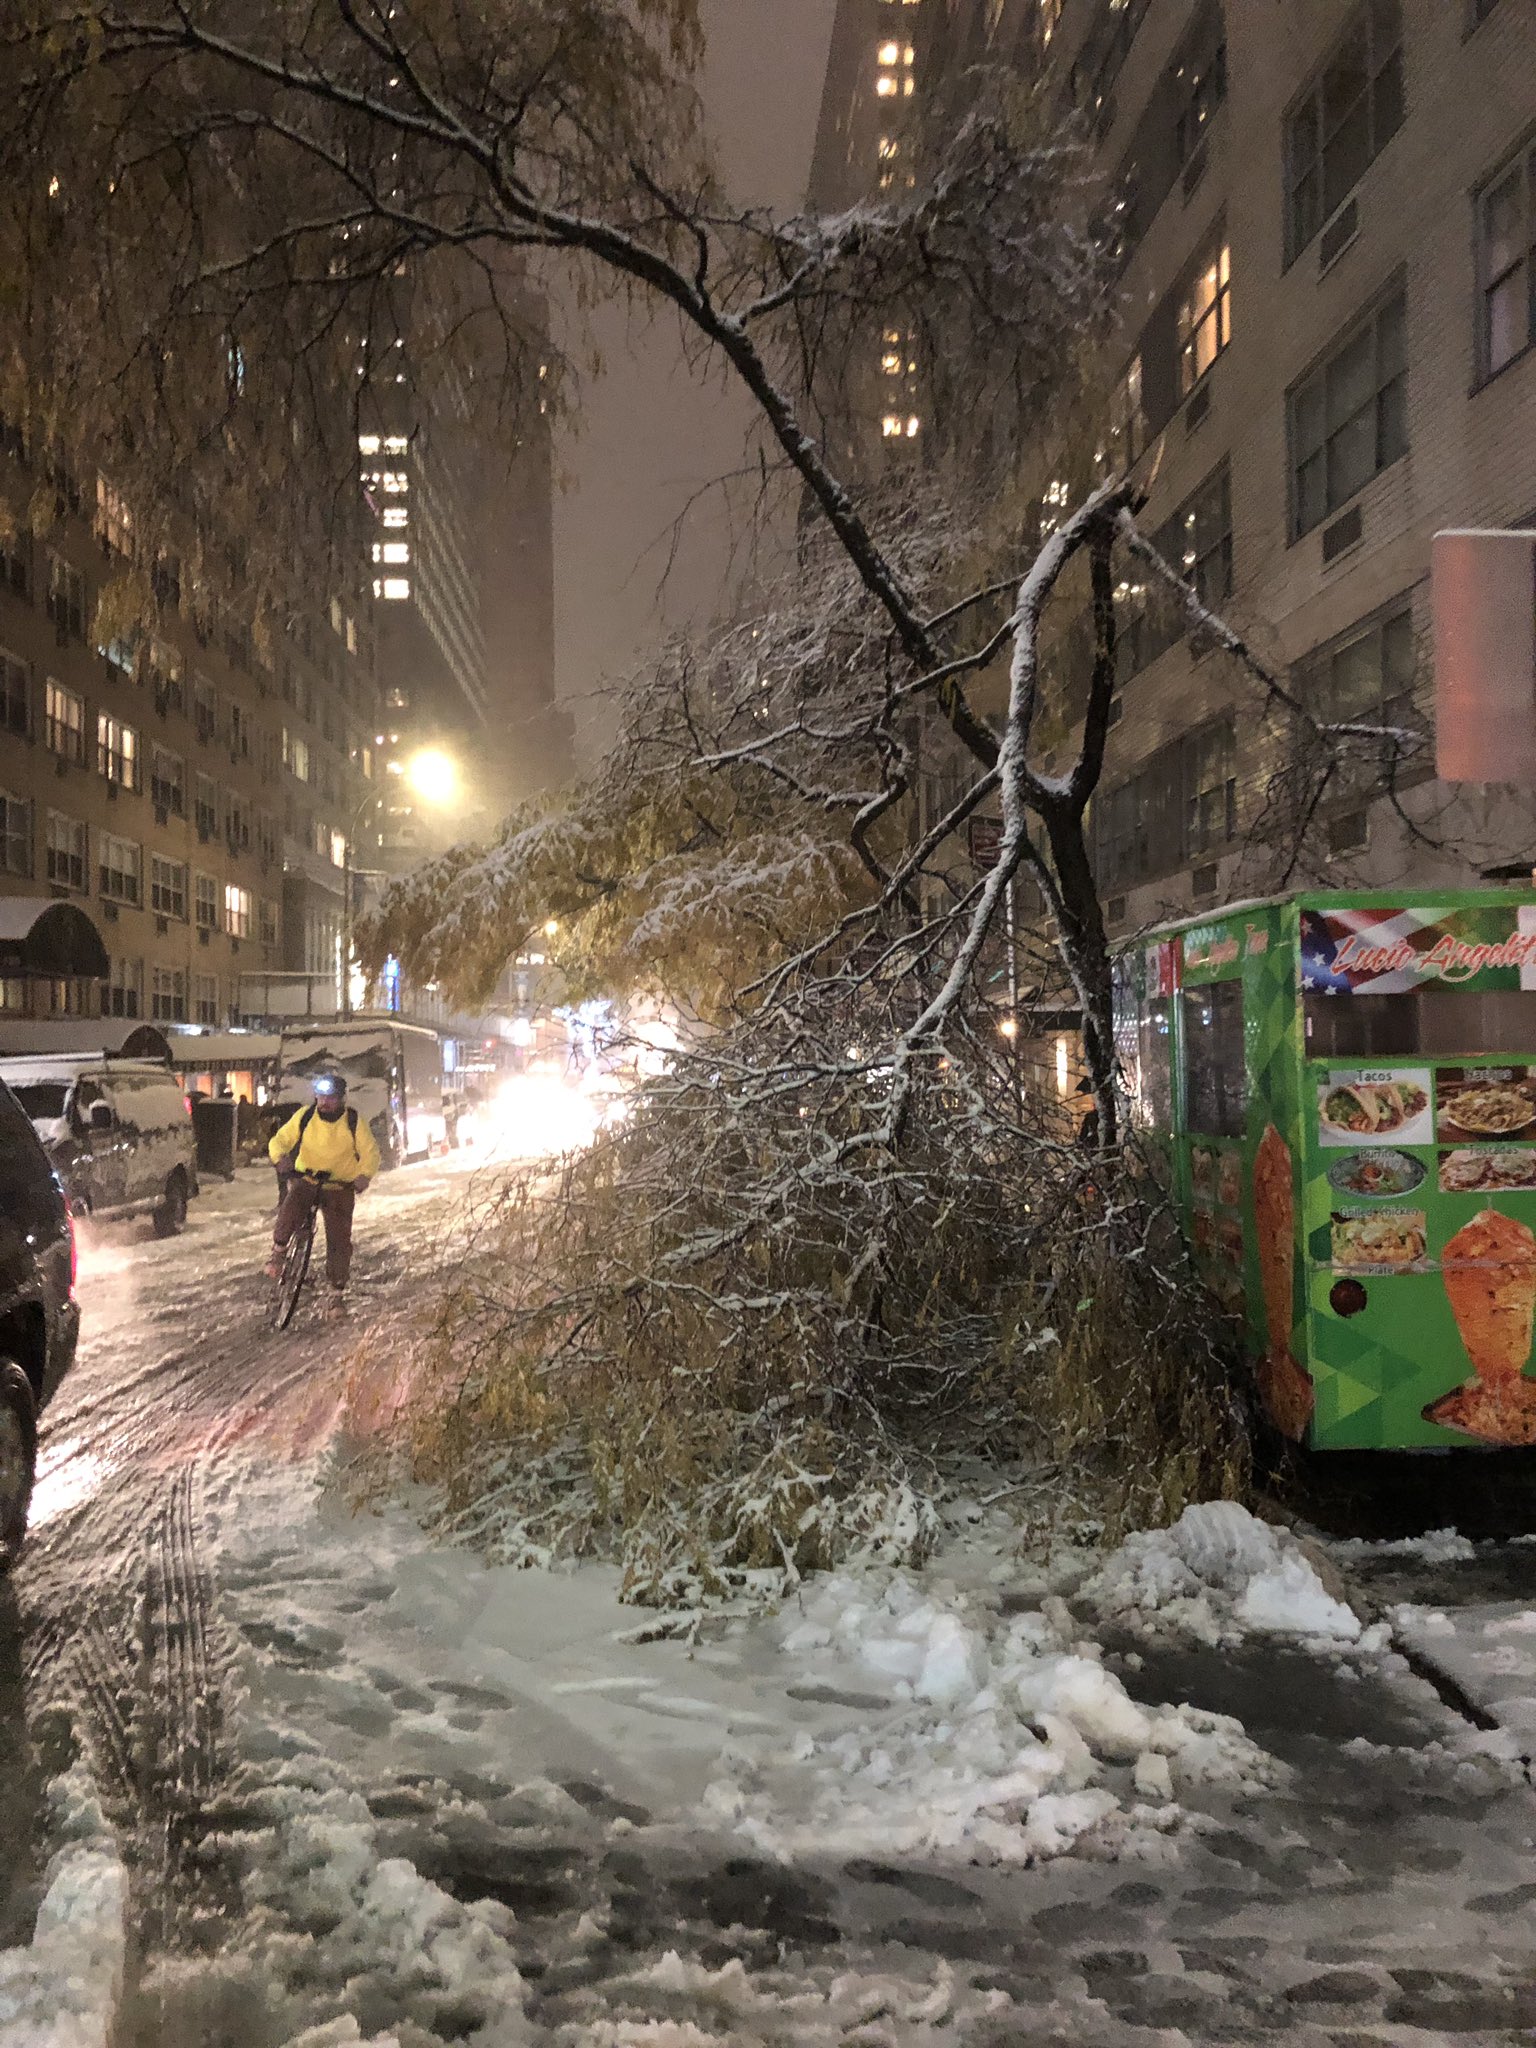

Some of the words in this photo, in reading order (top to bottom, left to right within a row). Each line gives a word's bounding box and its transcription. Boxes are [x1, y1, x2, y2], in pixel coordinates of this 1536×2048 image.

[1330, 935, 1416, 975] Lucio
[1356, 1069, 1393, 1082] Tacos
[1368, 1264, 1394, 1275] Plate
